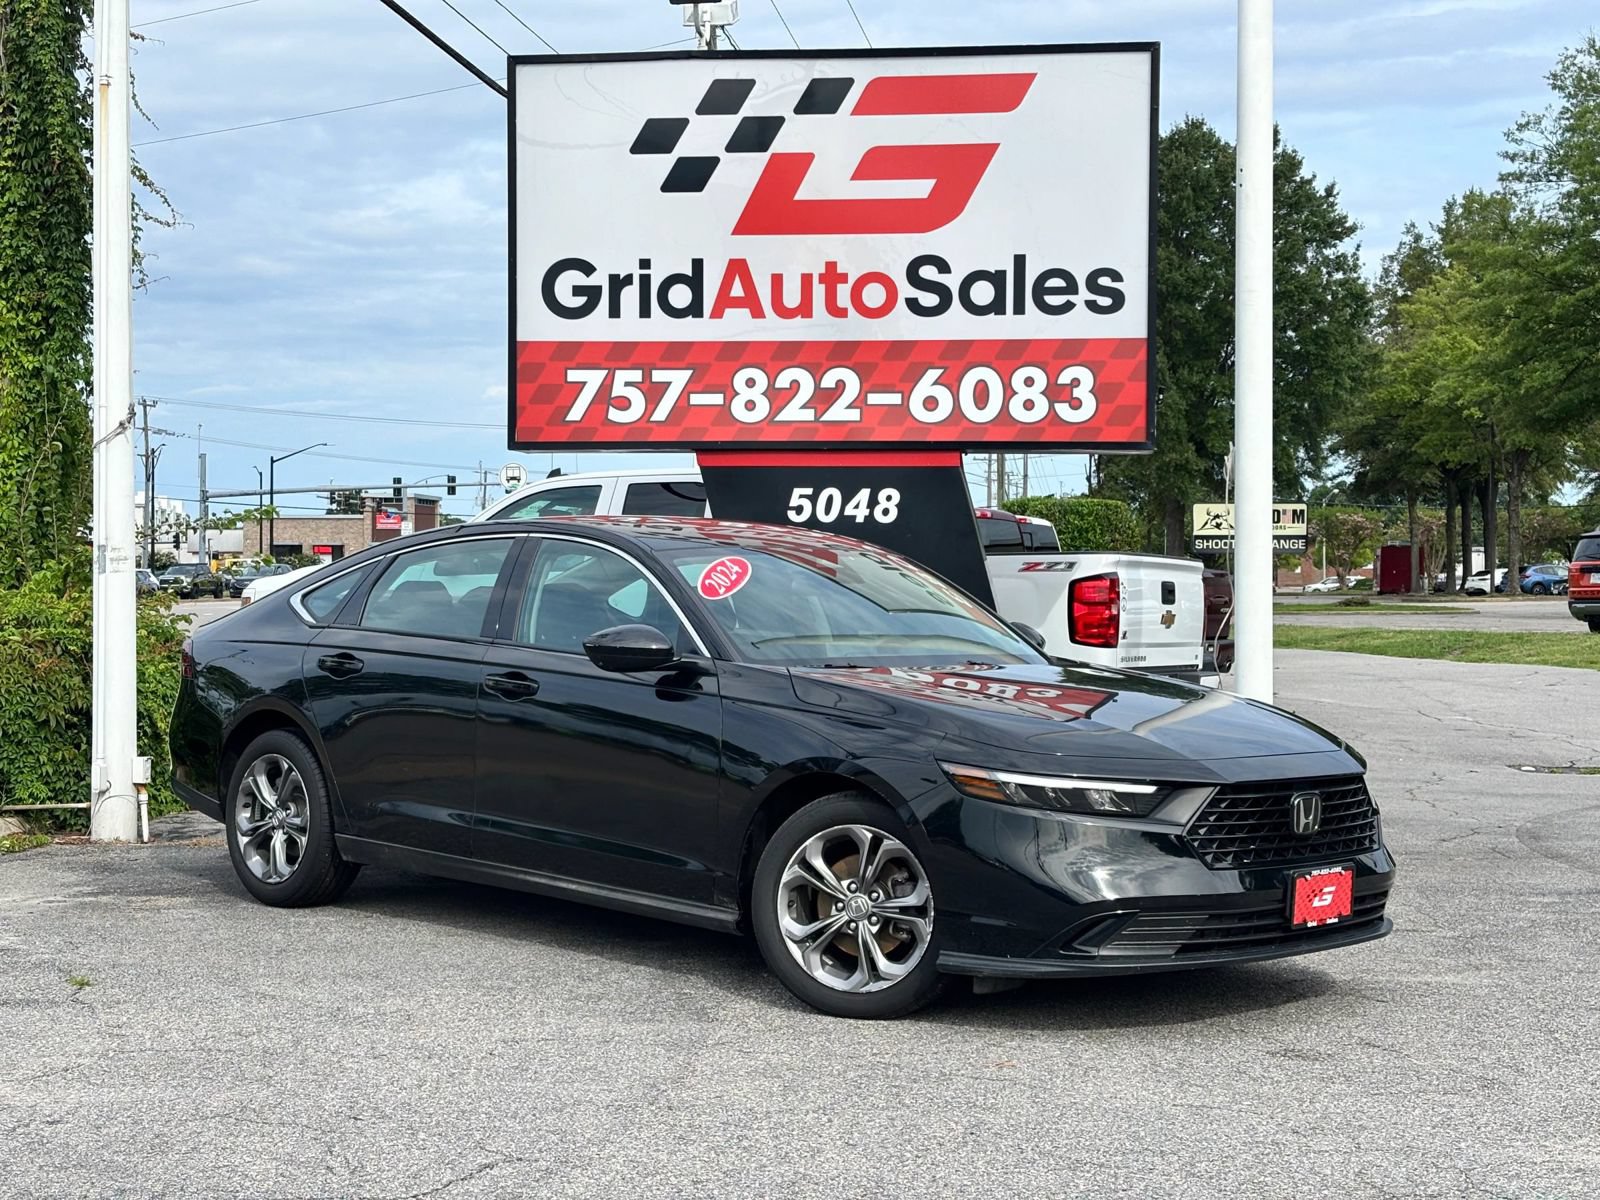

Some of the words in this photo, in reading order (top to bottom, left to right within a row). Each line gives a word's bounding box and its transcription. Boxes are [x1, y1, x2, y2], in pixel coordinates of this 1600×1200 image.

[541, 254, 1126, 320] GridAutoSales
[563, 366, 1098, 425] 757-822-6083
[787, 487, 900, 523] 5048
[1195, 539, 1235, 549] SHOOT
[1272, 539, 1306, 549] ANGE
[705, 559, 743, 595] 2024
[1018, 561, 1077, 572] Z71
